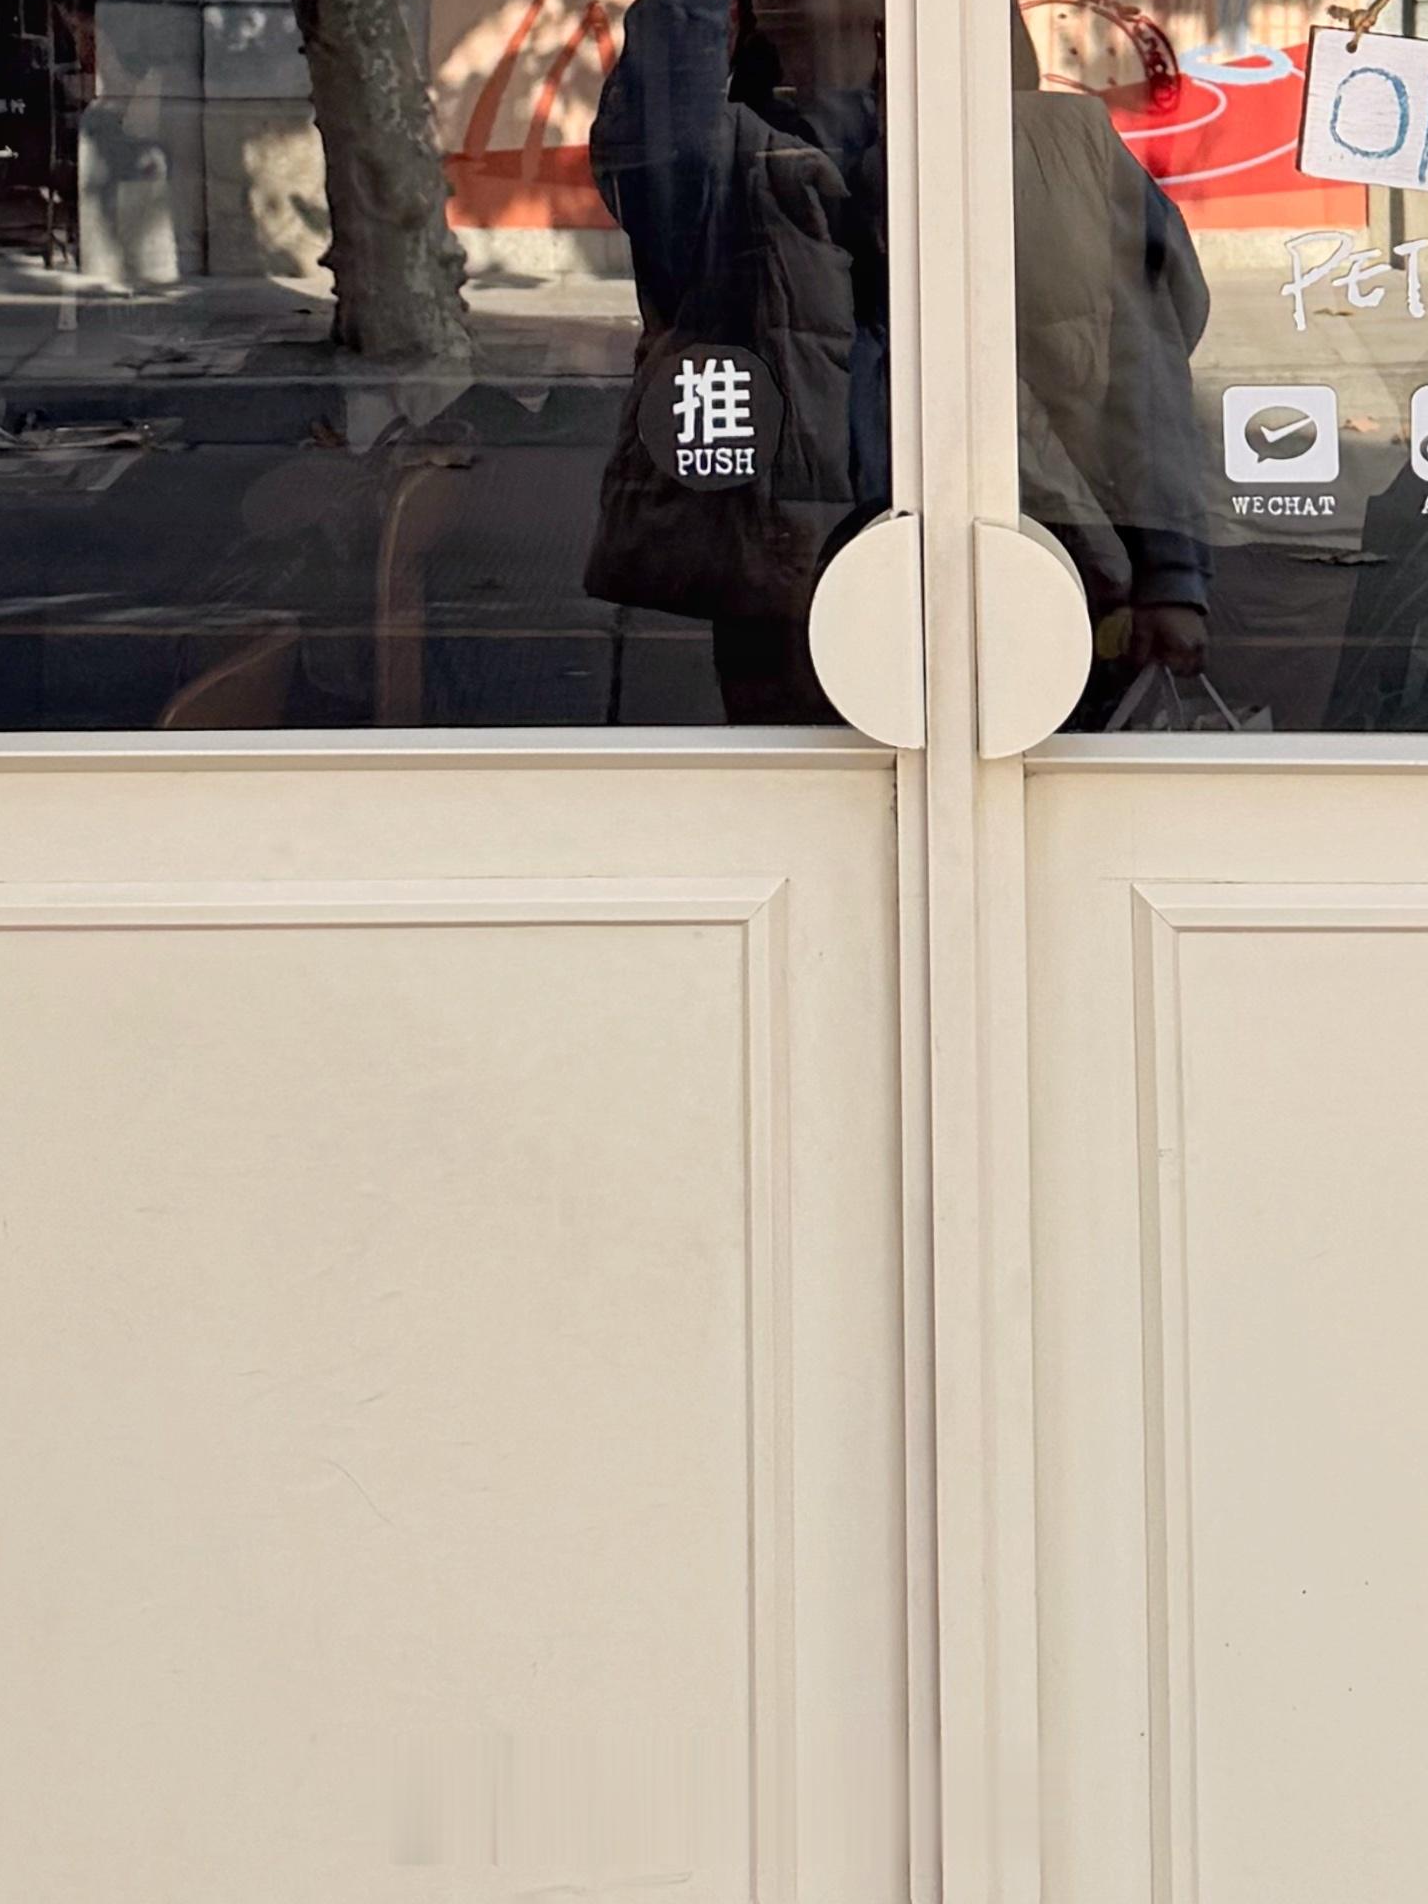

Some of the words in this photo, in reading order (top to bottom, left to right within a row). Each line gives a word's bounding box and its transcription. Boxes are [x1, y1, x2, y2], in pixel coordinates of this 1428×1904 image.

[673, 358, 755, 445] 推
[676, 447, 755, 476] PUSH
[1232, 496, 1335, 516] WECHAT
